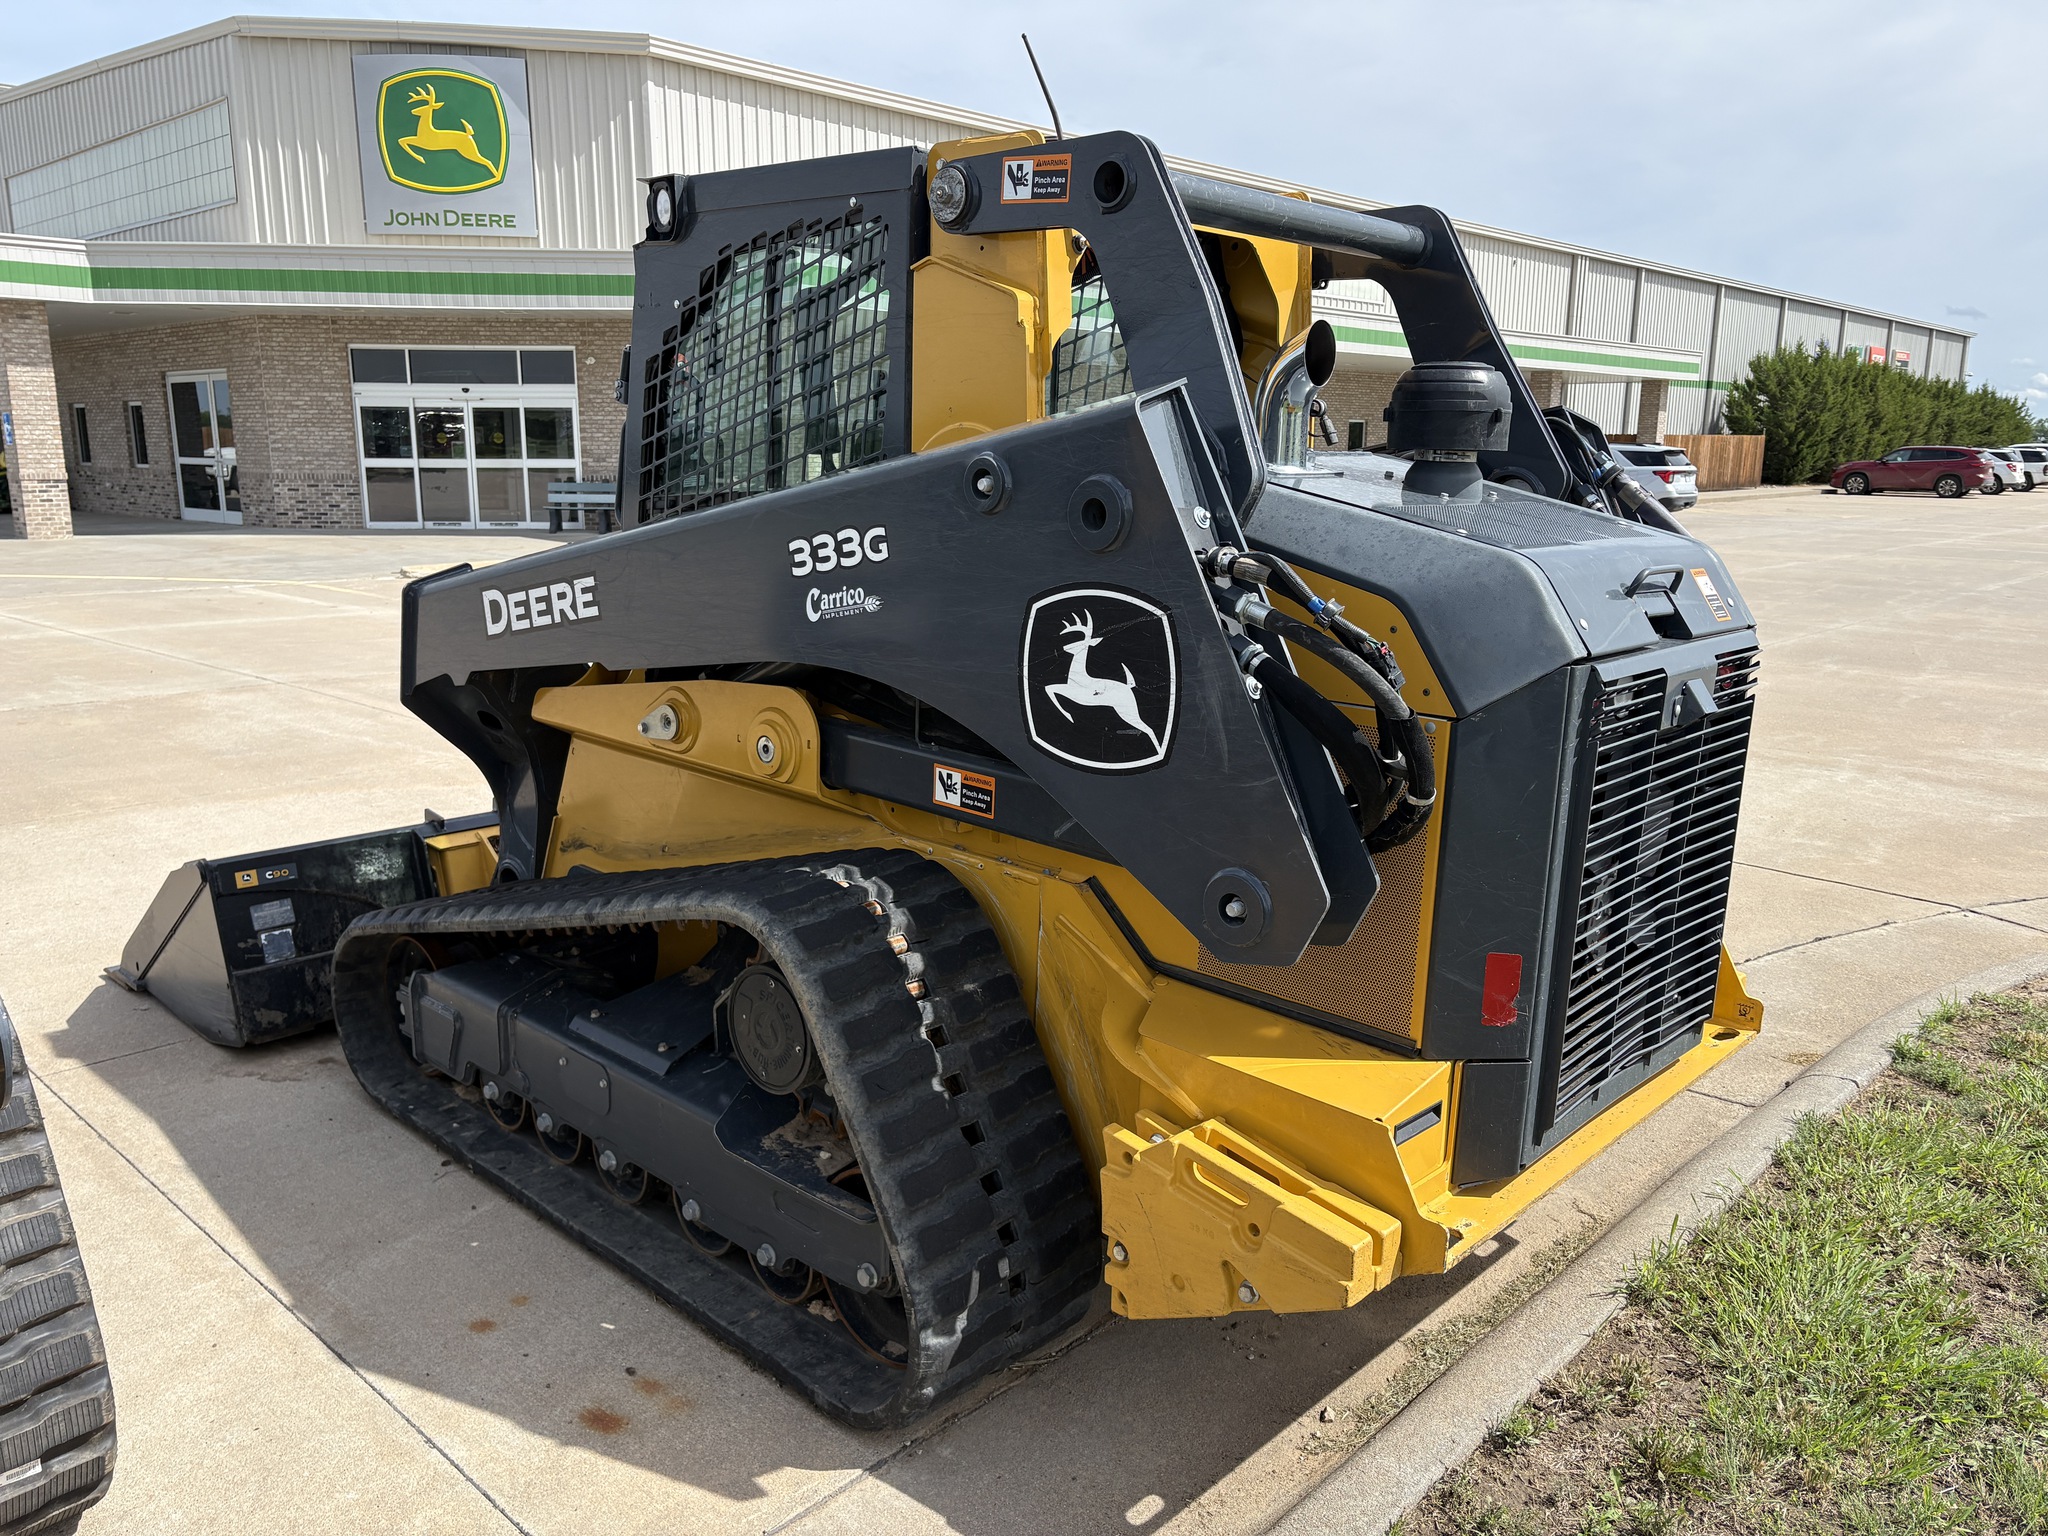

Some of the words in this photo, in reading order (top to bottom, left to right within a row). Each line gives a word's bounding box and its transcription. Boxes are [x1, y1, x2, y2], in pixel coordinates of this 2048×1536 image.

[1042, 159, 1068, 167] WARNING
[1034, 176, 1051, 184] Pinch
[1047, 186, 1061, 194] Away
[384, 209, 440, 226] JOHN
[443, 209, 517, 228] DEERE
[788, 527, 889, 576] 333G
[482, 576, 599, 635] DEERE
[806, 586, 865, 622] Carrico
[822, 607, 864, 620] IMPLEMENT
[968, 776, 992, 787] WARNING
[962, 788, 977, 798] Pinch
[978, 793, 991, 801] Area
[974, 800, 986, 809] Away
[265, 868, 289, 879] C90
